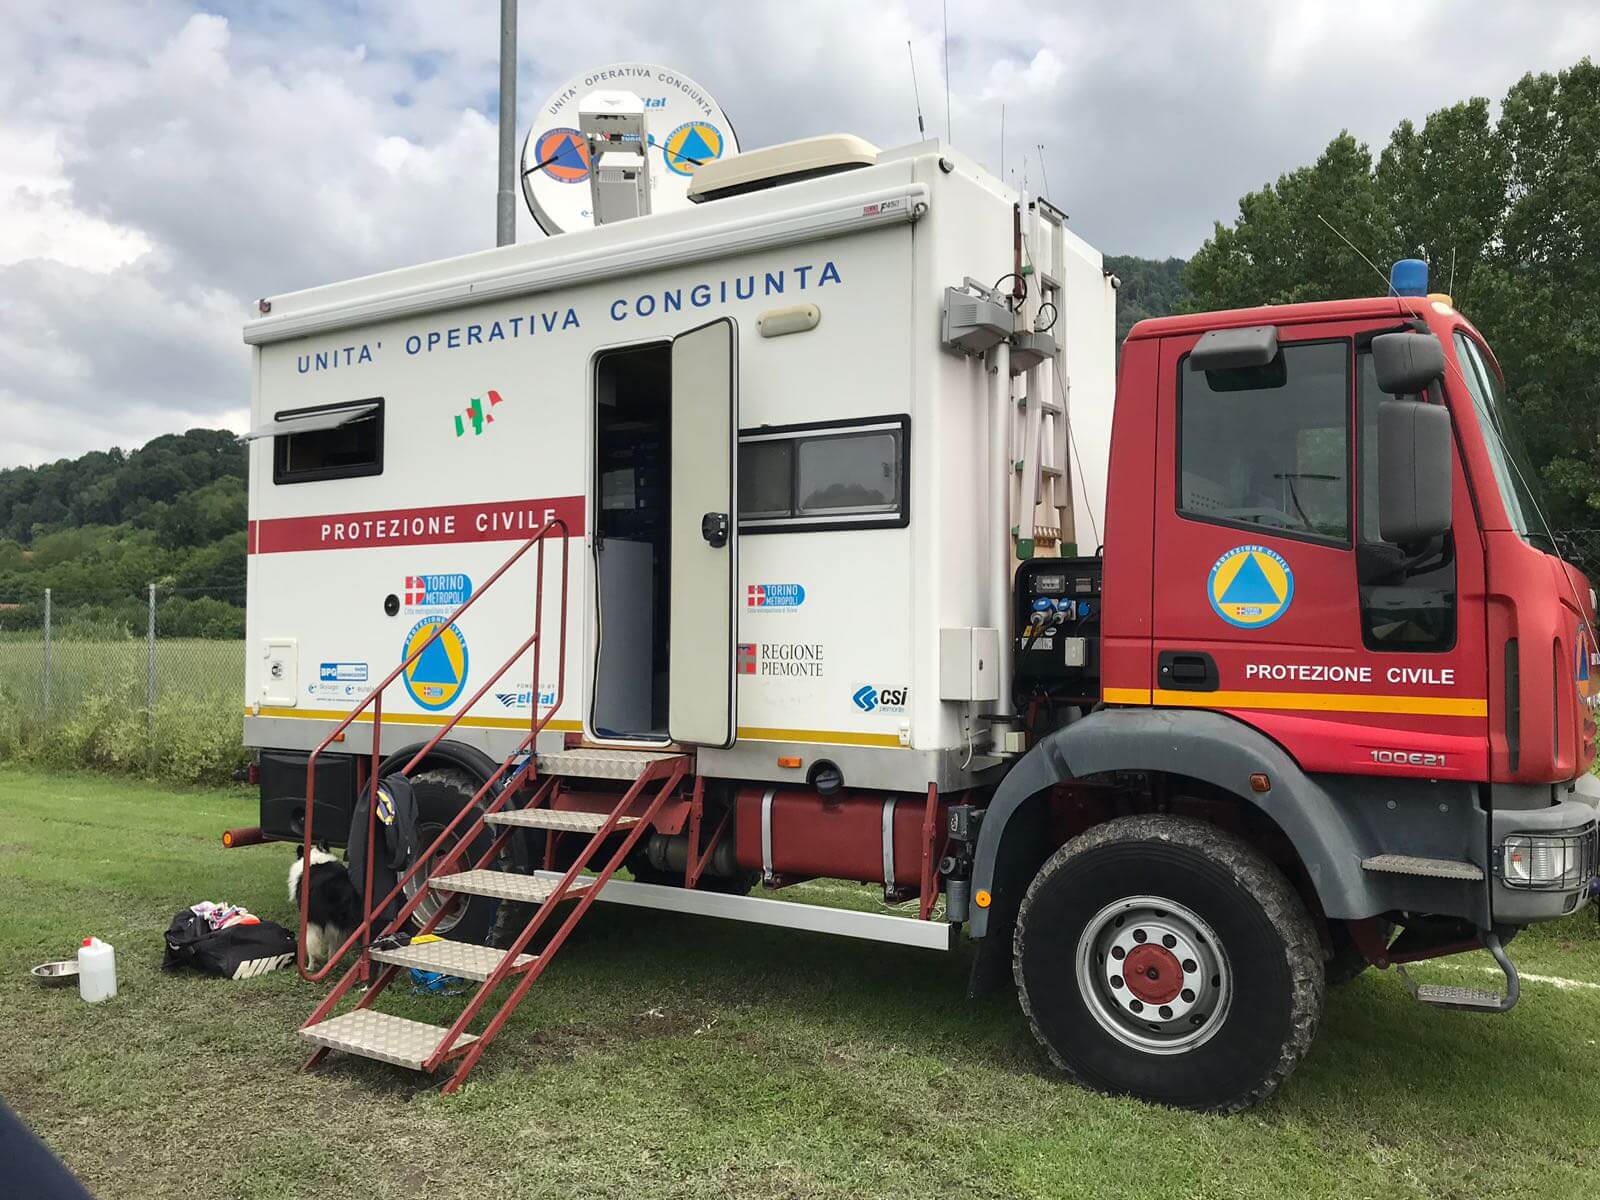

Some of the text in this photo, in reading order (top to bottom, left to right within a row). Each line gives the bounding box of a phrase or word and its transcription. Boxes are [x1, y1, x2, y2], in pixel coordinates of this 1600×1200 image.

[585, 68, 651, 87] OPERATIVA
[657, 73, 713, 117] CONGIUNTA
[297, 261, 842, 373] UNITA' OPERATIVA CONGIUNTA
[321, 509, 556, 541] PROTEZIONE CIVILE
[1213, 545, 1290, 573] PROTEZIONE CIVILE
[426, 575, 464, 592] TORINO
[766, 585, 798, 596] TORINO
[426, 591, 464, 604] METROPOLI
[766, 596, 798, 605] METROPOLI
[449, 624, 468, 650] IVILE
[761, 643, 824, 661] REGIONE
[761, 661, 824, 677] PIEMONTE
[1246, 664, 1455, 684] PROTEZIONE CIVILE
[1370, 750, 1446, 767] 100E21
